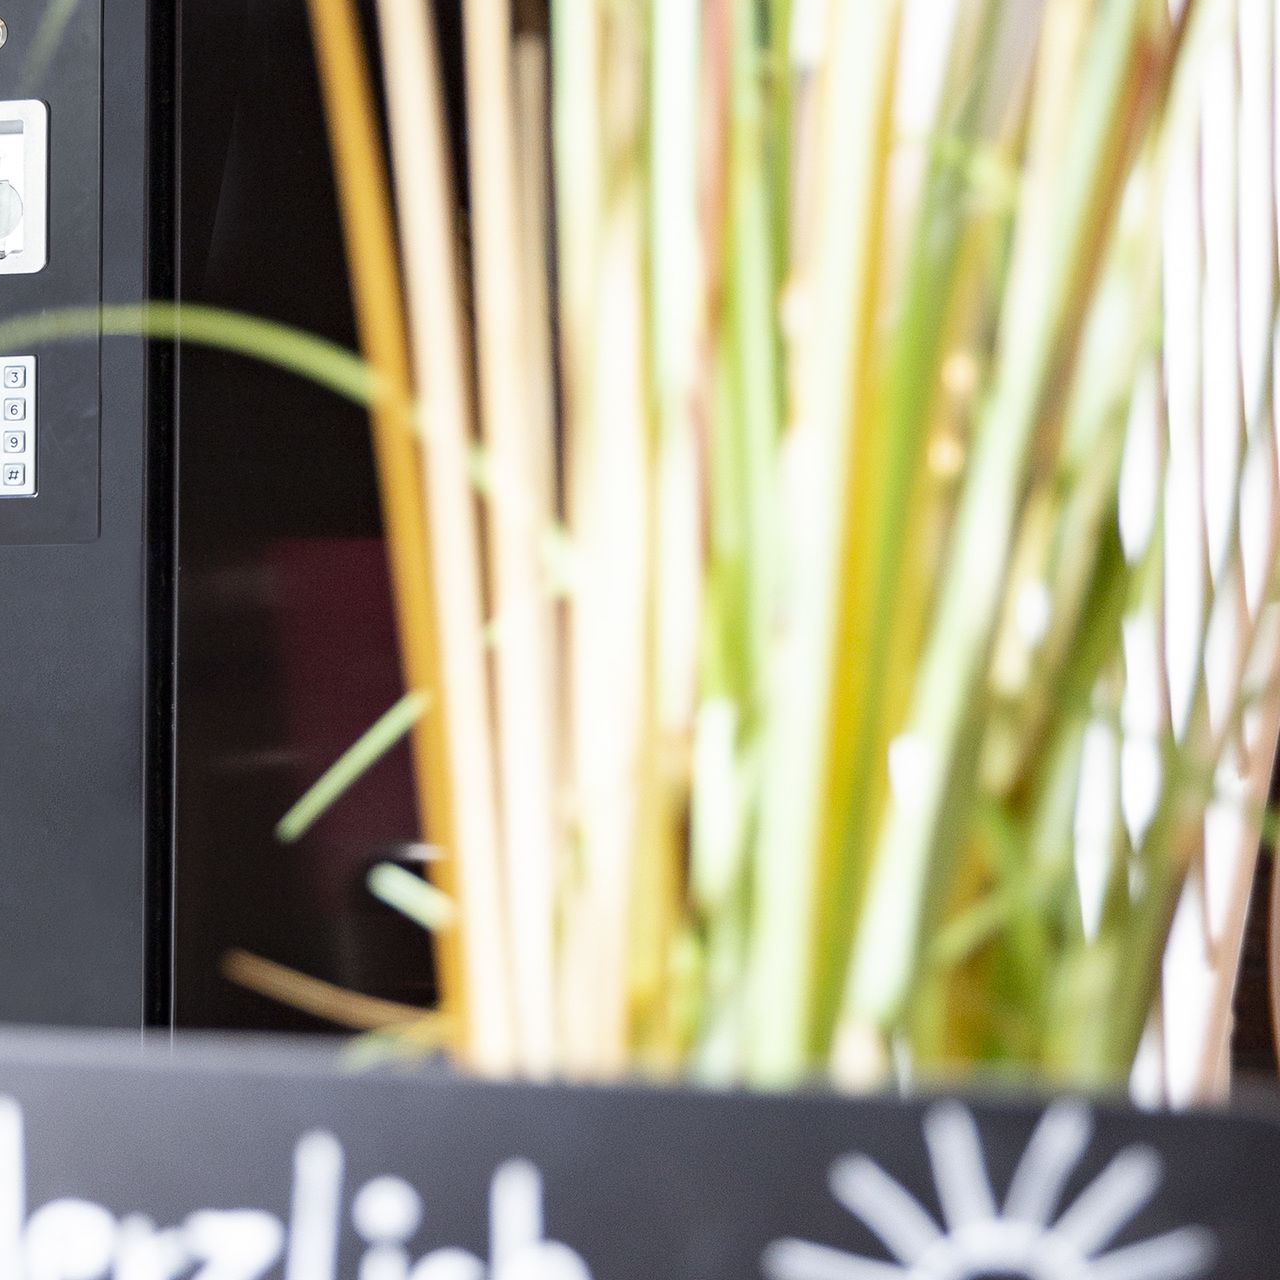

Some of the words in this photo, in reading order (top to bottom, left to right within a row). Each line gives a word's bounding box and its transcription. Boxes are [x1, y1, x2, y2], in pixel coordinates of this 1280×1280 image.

[11, 372, 19, 383] 3
[10, 404, 19, 416] 6
[9, 437, 18, 448] 9
